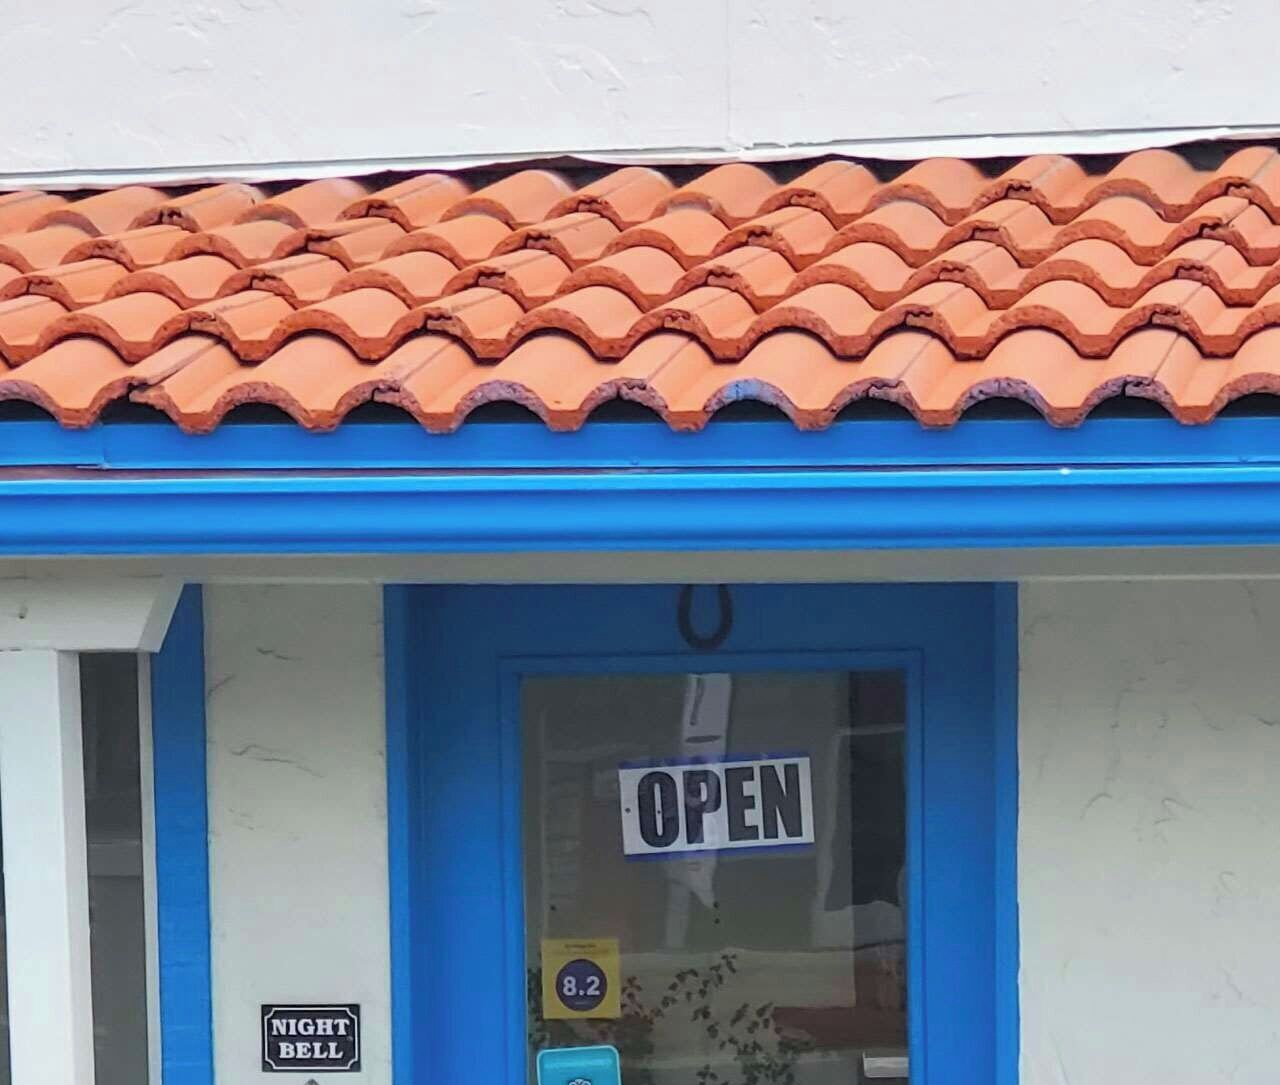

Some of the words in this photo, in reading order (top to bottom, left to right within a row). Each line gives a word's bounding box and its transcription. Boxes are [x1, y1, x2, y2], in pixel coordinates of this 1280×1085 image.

[637, 763, 804, 848] OPEN
[562, 975, 601, 996] 8.2
[271, 1018, 350, 1036] NIGHT
[278, 1042, 344, 1059] BELL
